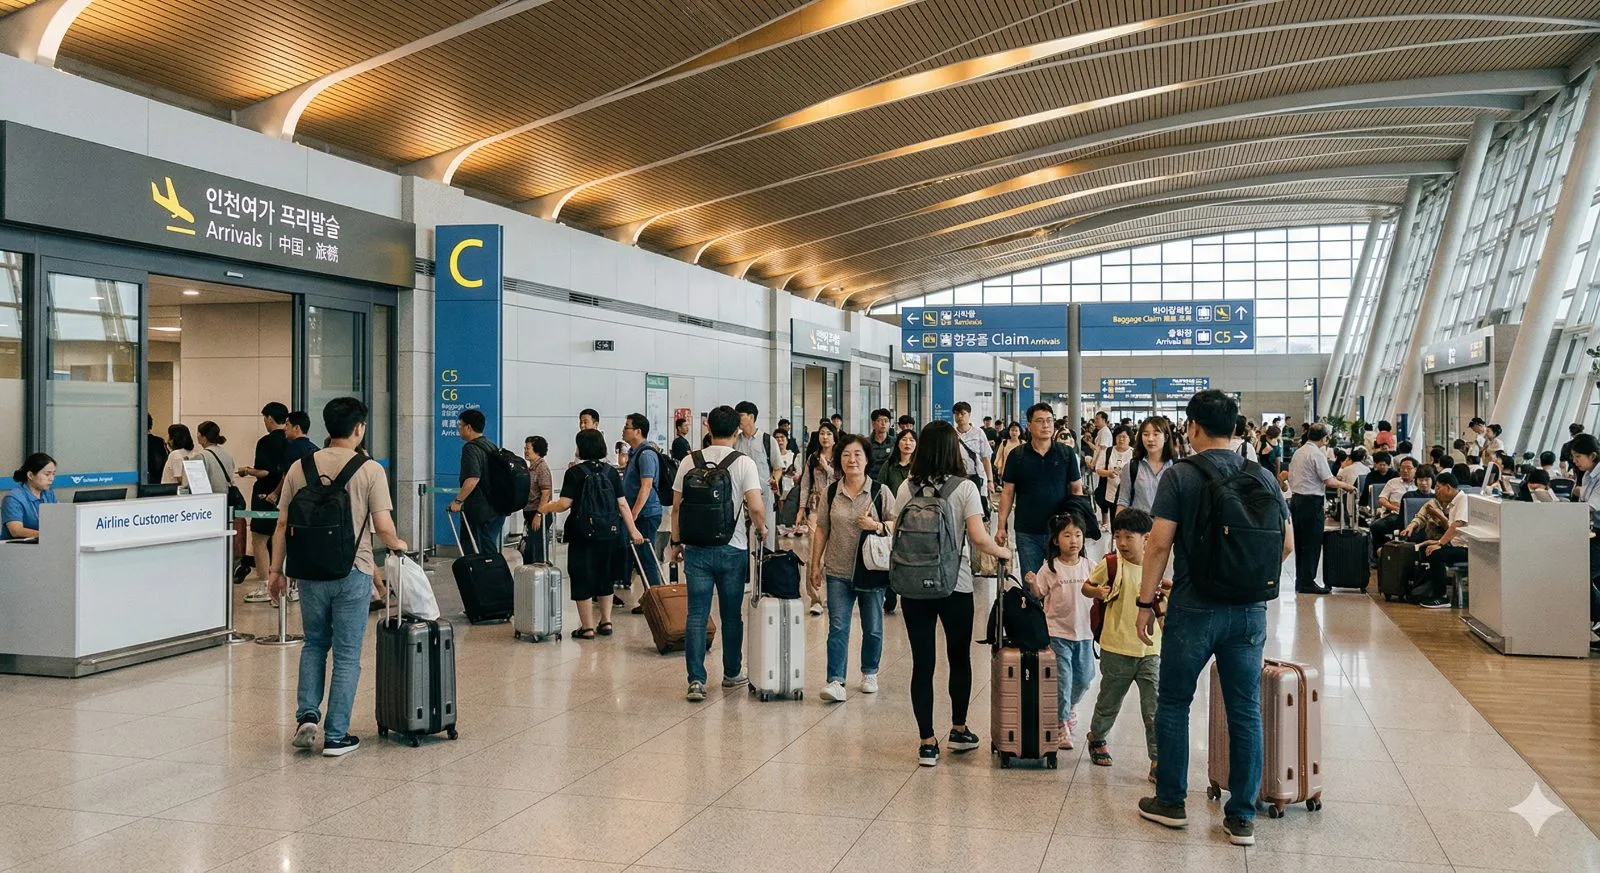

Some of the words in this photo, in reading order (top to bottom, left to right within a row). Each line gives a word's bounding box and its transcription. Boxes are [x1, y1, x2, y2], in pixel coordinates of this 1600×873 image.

[206, 187, 275, 225] 인천여가
[280, 204, 340, 240] 프리발슬
[206, 220, 263, 248] Arrivals
[450, 238, 483, 288] C
[992, 333, 1029, 346] Claim
[1214, 331, 1231, 344] C5
[937, 358, 949, 375] C
[441, 369, 458, 383] C5
[1022, 376, 1031, 389] C
[441, 388, 458, 401] C6
[96, 516, 130, 530] Airline
[132, 513, 179, 527] Customer
[180, 508, 213, 522] Service
